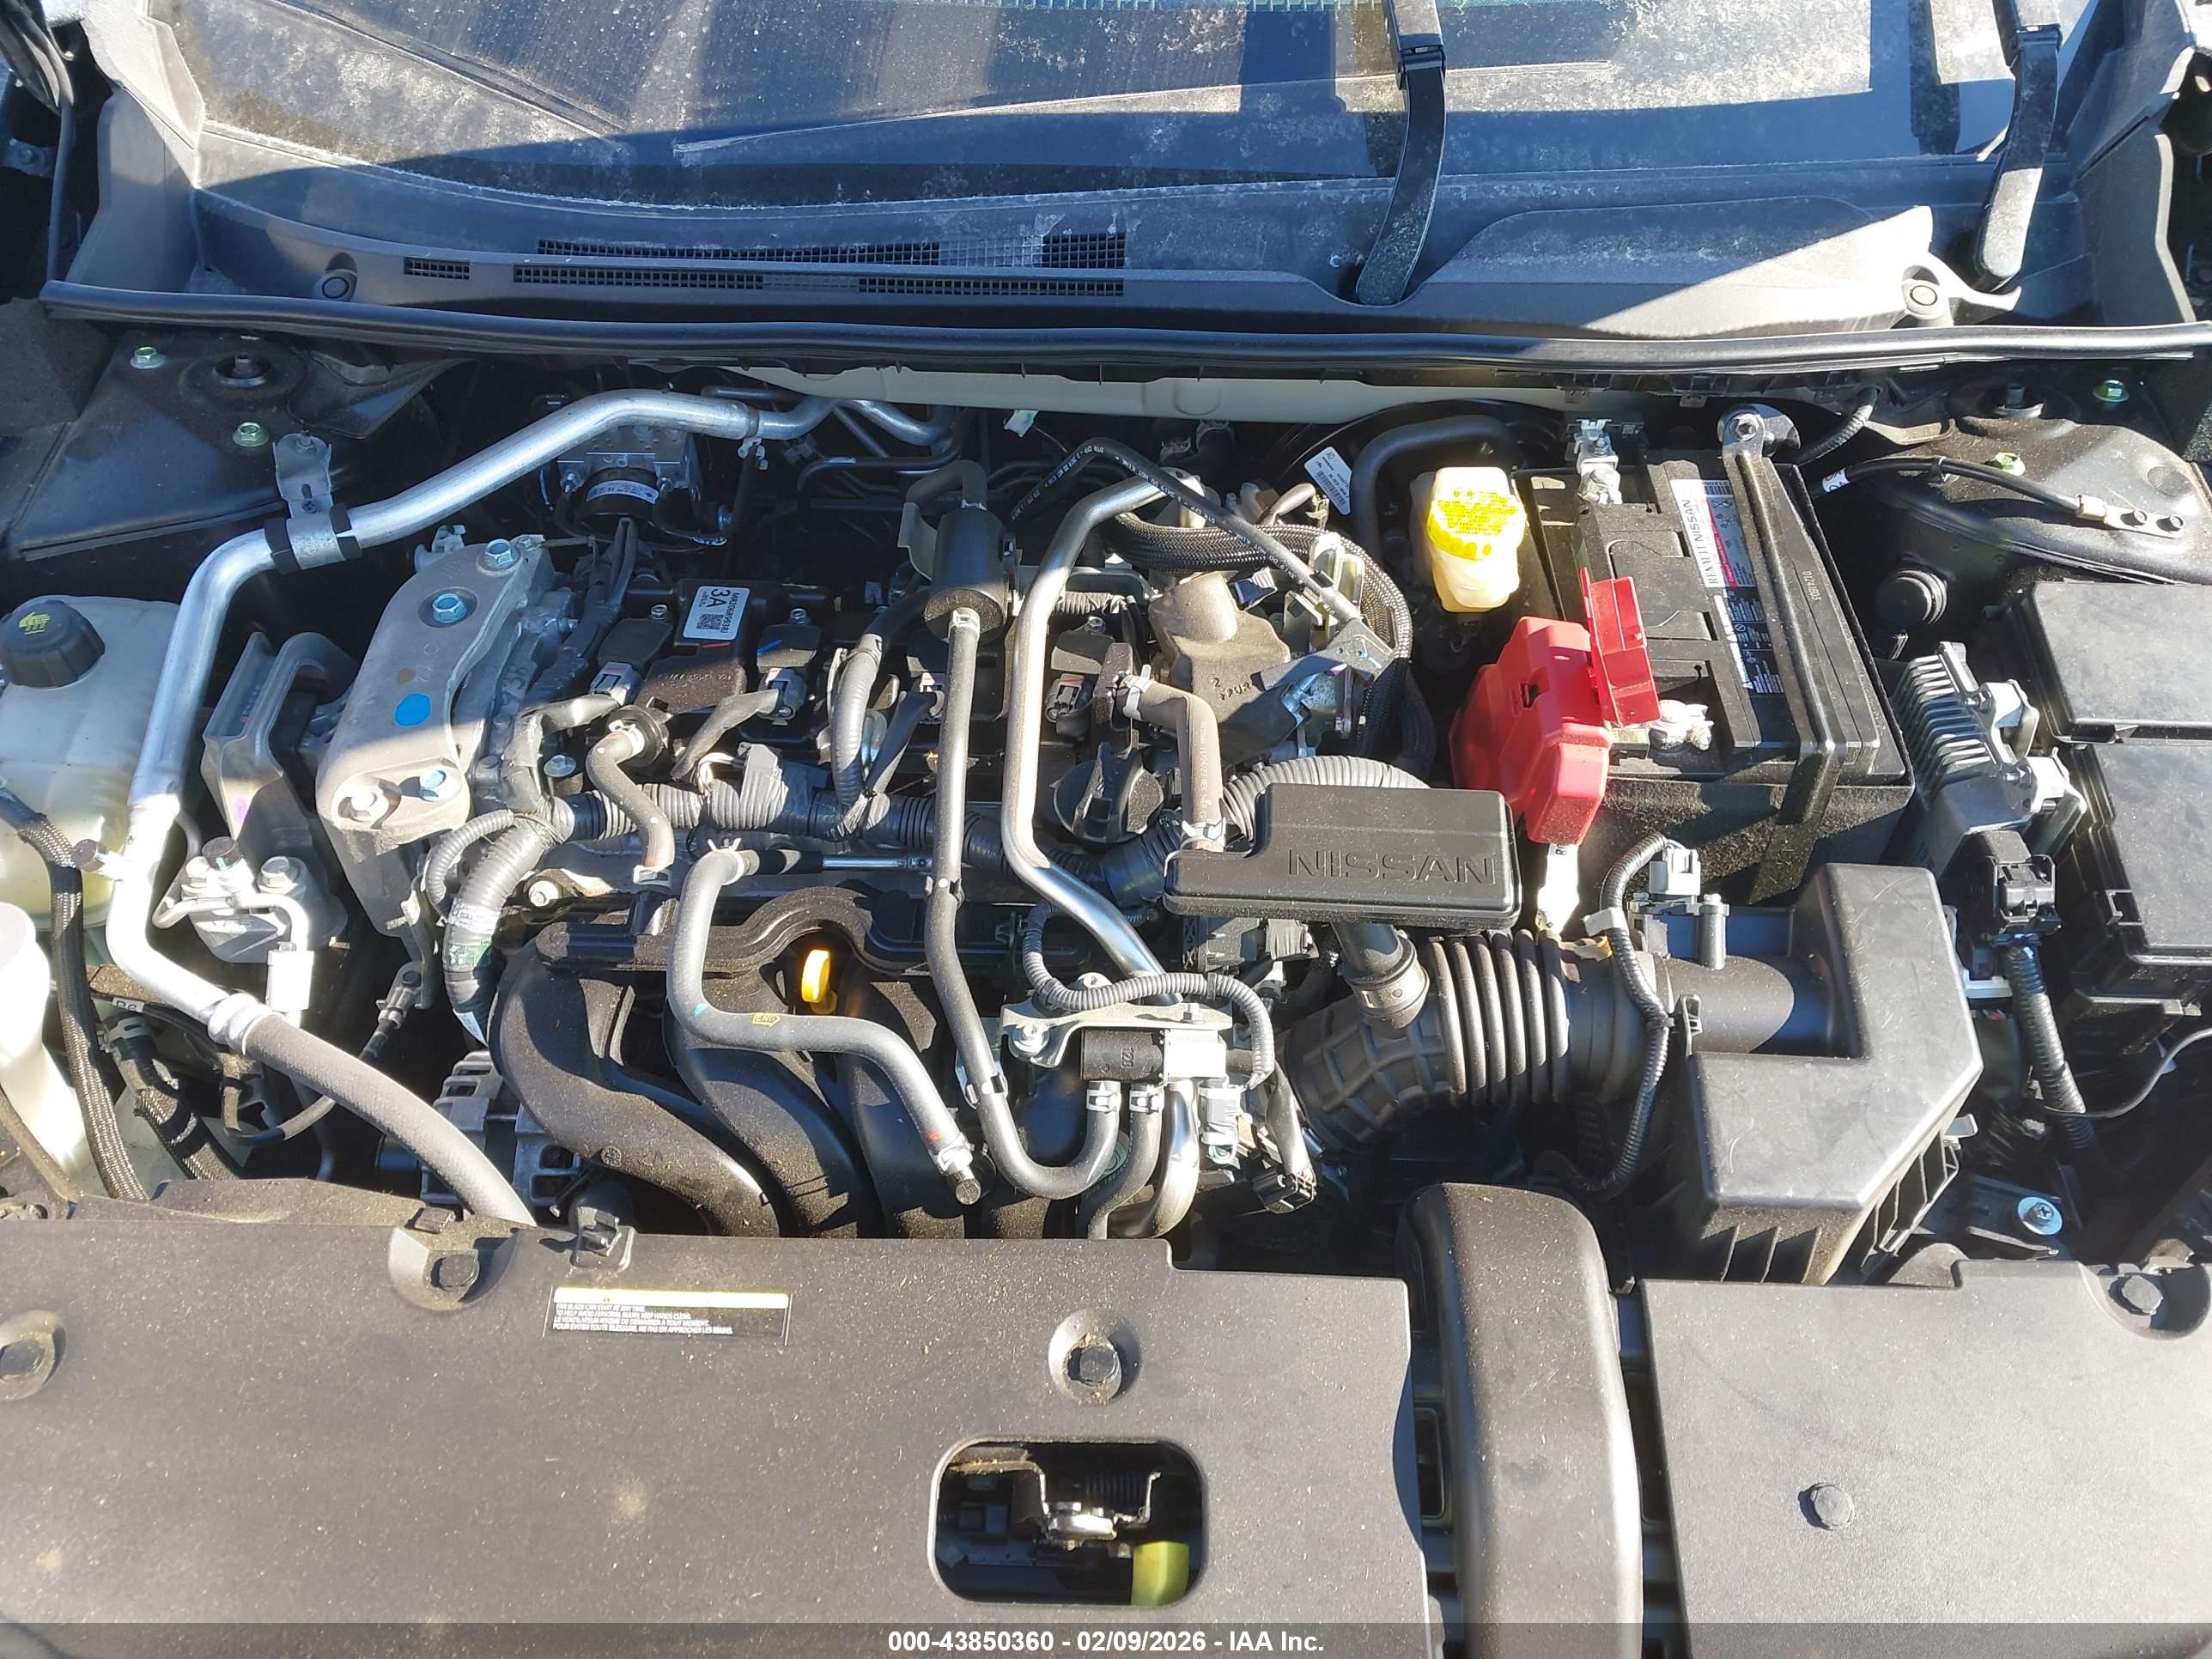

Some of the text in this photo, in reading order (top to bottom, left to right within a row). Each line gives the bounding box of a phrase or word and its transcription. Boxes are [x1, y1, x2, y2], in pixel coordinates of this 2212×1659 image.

[1233, 529, 1252, 546] KINK
[1680, 499, 1704, 542] NISSAN
[1696, 541, 1718, 585] RENAULT
[706, 588, 731, 608] 3A
[1288, 848, 1498, 886] NISSAN
